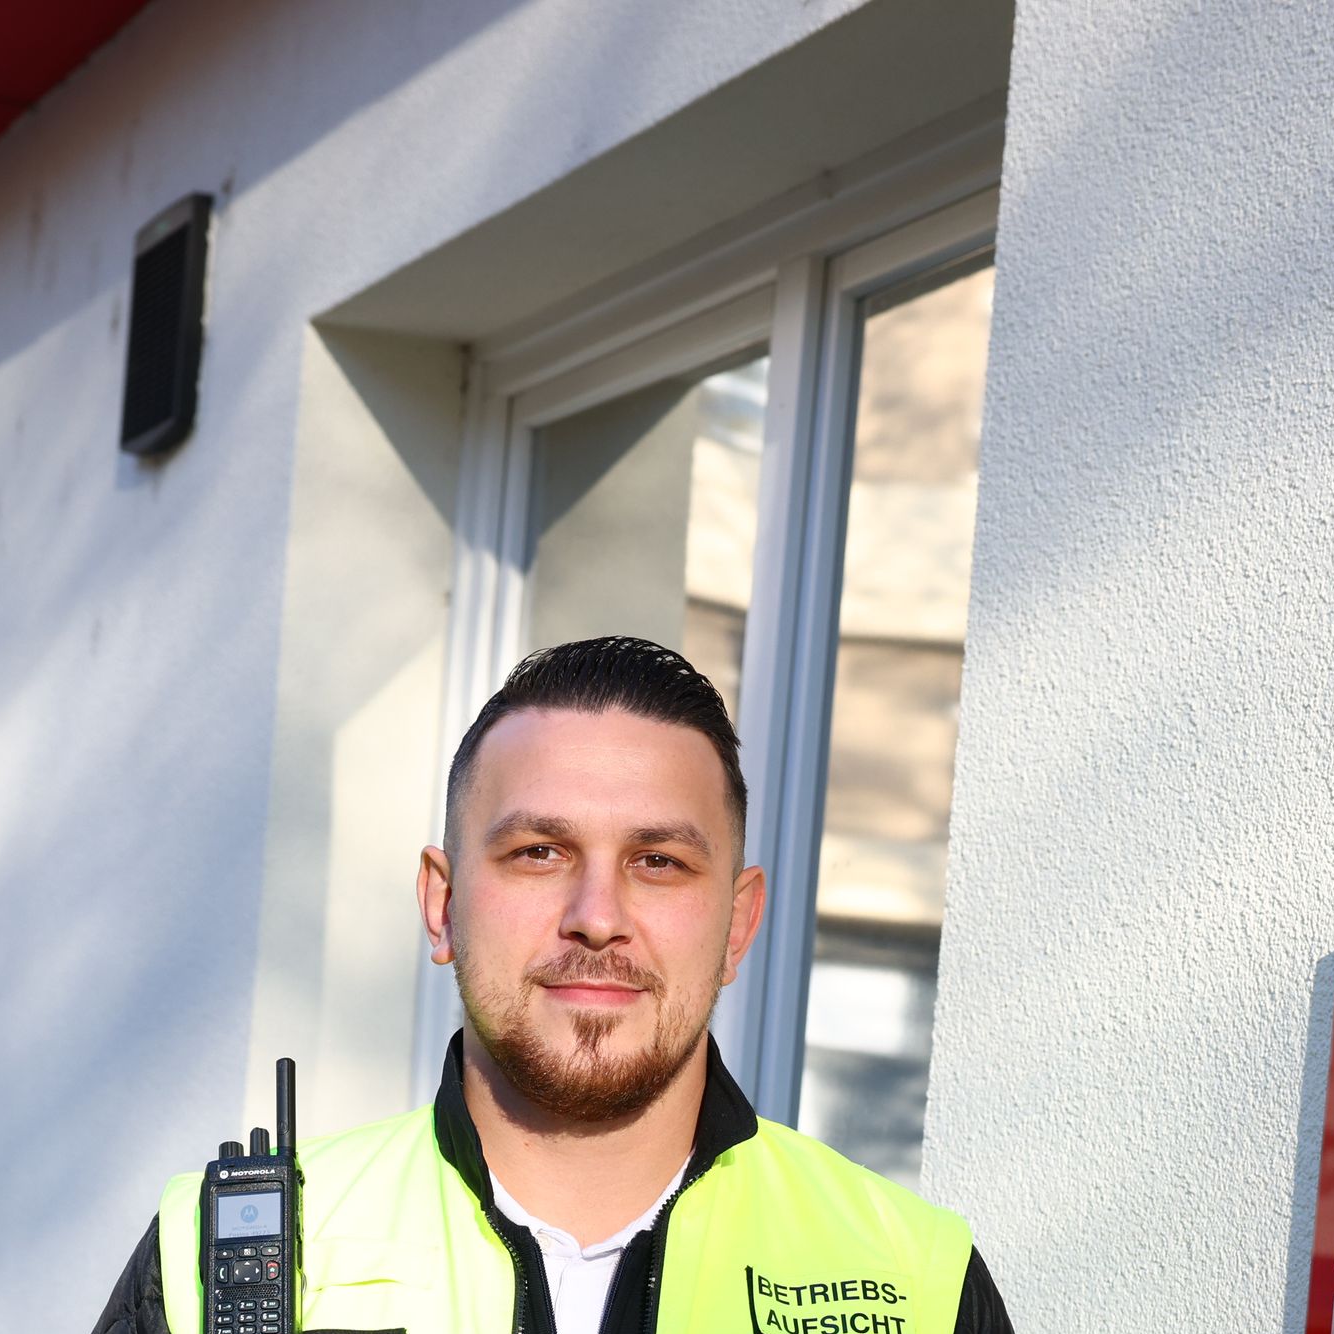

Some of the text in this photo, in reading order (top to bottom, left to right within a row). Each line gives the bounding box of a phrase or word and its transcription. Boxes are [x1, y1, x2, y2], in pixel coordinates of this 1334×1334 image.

[231, 1169, 276, 1177] MOTOROLA
[757, 1275, 907, 1306] BETRIEBS-
[262, 1300, 268, 1308] 3
[262, 1312, 268, 1320] 6
[240, 1326, 245, 1334] 8
